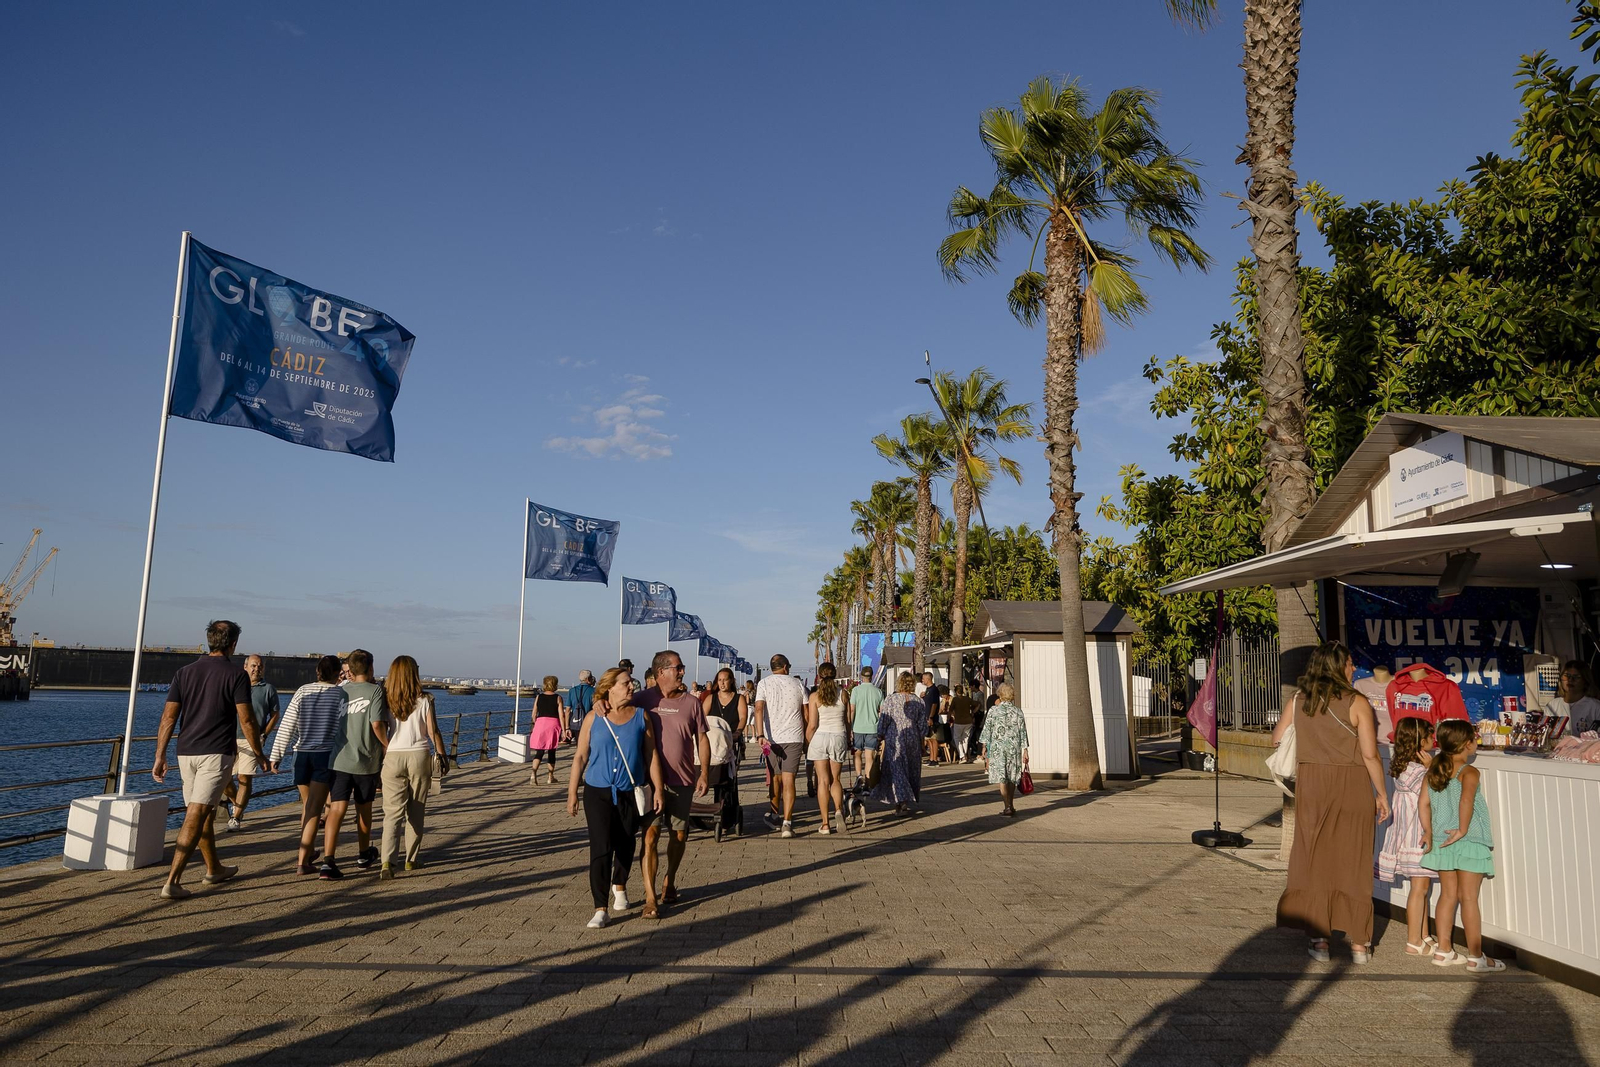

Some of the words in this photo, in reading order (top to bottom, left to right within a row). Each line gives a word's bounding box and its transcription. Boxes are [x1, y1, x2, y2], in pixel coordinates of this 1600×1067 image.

[274, 331, 306, 345] GRANDE
[310, 339, 335, 351] ROUTE
[270, 346, 326, 376] CÁDIZ
[220, 352, 235, 364] DEL
[237, 358, 242, 367] 6
[244, 361, 253, 371] AL
[257, 365, 266, 375] 14
[270, 369, 280, 379] DE
[284, 372, 336, 391] SEPTIEMBRE
[339, 383, 351, 394] DE
[353, 386, 375, 399] 2025
[328, 405, 363, 418] Diputación
[338, 415, 356, 425] Cádiz
[1408, 460, 1434, 477] Ayuntamiento
[1435, 458, 1440, 467] de
[1441, 453, 1454, 465] Cádiz
[1365, 618, 1481, 646] VUELVE
[1491, 620, 1526, 648] YA
[1445, 656, 1501, 686] 3X4
